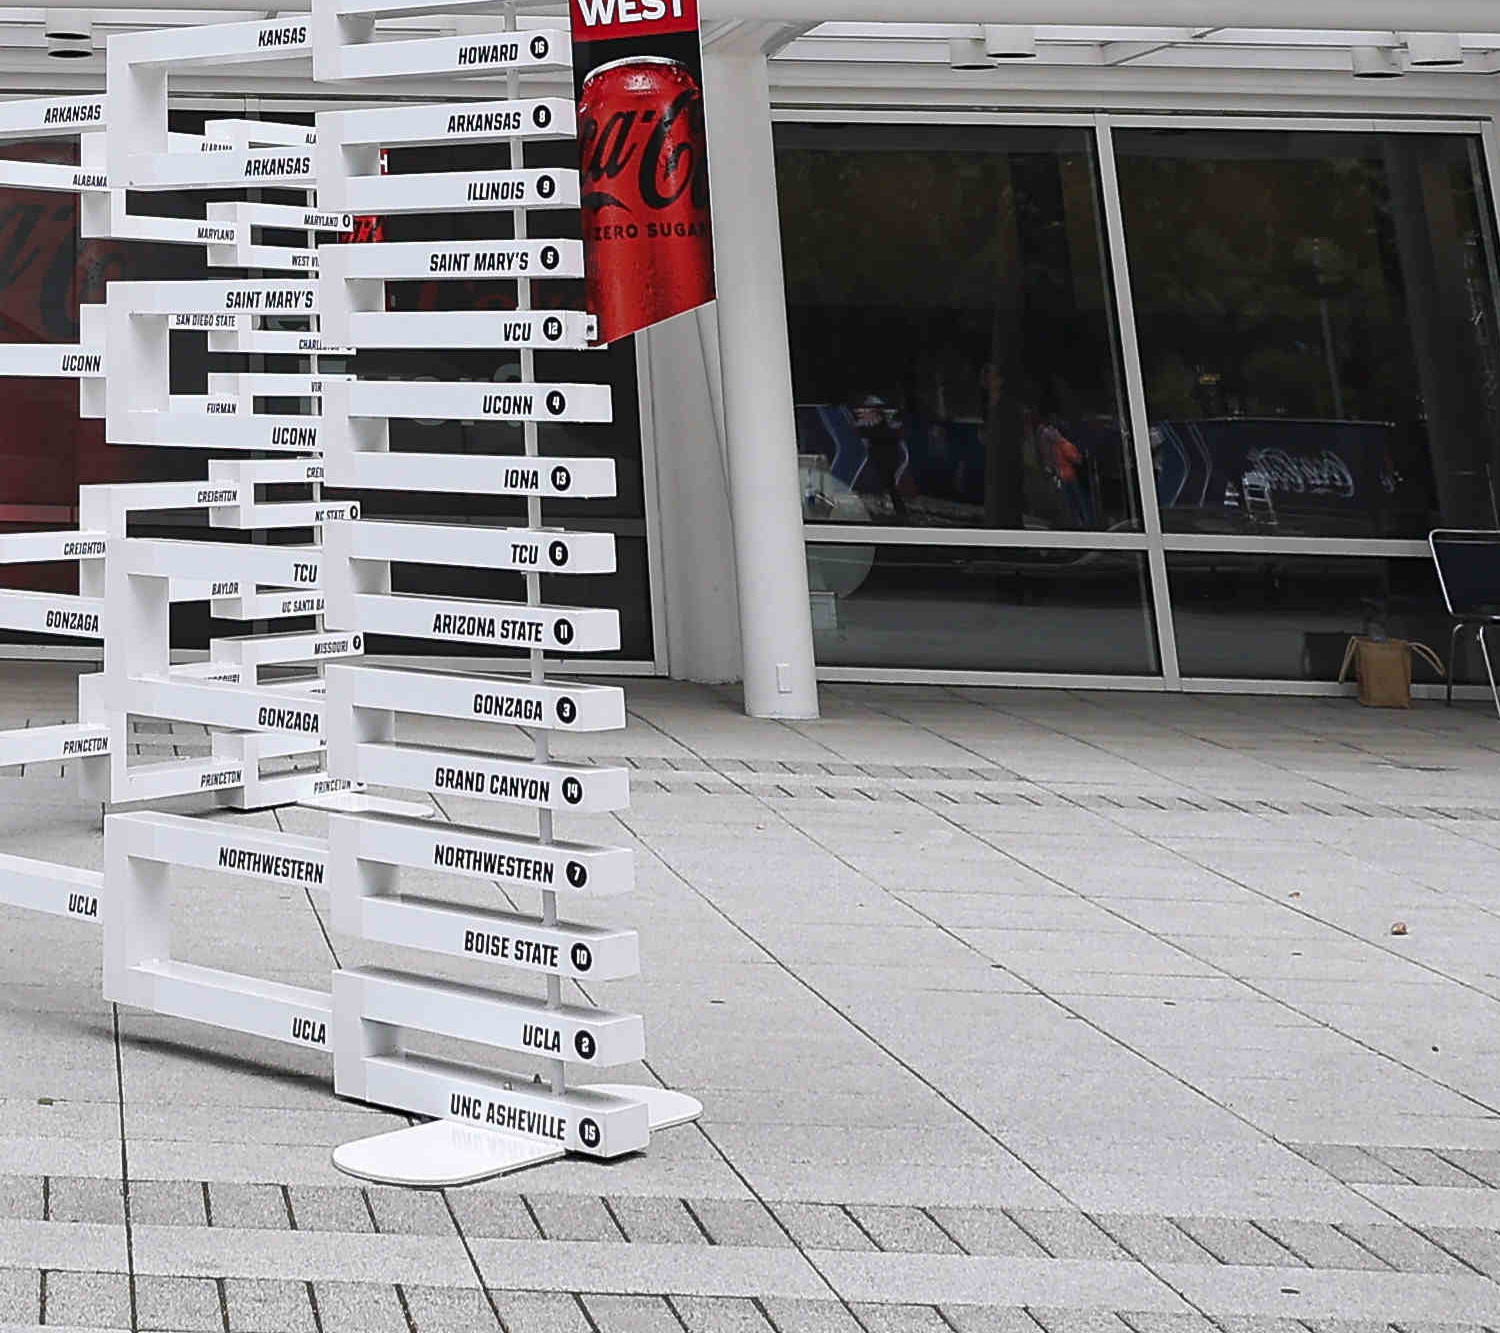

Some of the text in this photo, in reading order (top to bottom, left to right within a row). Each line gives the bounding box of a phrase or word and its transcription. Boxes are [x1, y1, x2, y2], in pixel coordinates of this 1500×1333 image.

[259, 27, 306, 46] KANSAS
[459, 44, 518, 64] HOWARD
[44, 105, 101, 123] ARKANSAS
[448, 112, 521, 133] ARKANSAS
[245, 157, 310, 176] ARKANSAS
[468, 182, 524, 200] ILLINOIS
[304, 215, 338, 227] MARYLAND
[198, 228, 234, 240] MARYLAND
[593, 225, 638, 243] ZERO
[430, 252, 528, 271] SAINT MARY'S
[226, 291, 313, 308] SAINT MARY'S
[504, 323, 531, 341] VCU
[62, 356, 101, 371] UCONN
[483, 395, 532, 414] UCONN
[272, 427, 316, 446] UCONN
[504, 469, 538, 489] IONA
[511, 544, 538, 564] TCU
[294, 564, 317, 582] TCU
[46, 611, 98, 632] GONZAGA
[433, 614, 495, 637] ARIZONA
[501, 620, 543, 642] STATE
[474, 694, 542, 721] GONZAGA
[259, 707, 318, 733] GONZAGA
[64, 738, 108, 753] PRINCETON
[201, 771, 241, 787] PRINCETON
[436, 768, 485, 792] GRAND
[490, 775, 549, 802] CANYON
[219, 848, 323, 883] NORTHWESTERN
[435, 845, 553, 883] NORTHWESTERN
[69, 894, 97, 917] UCLA
[465, 931, 509, 958] BOISE
[515, 940, 558, 967] STATE
[293, 1018, 325, 1047] UCLA
[523, 1025, 560, 1052] UCLA
[451, 1094, 481, 1119] UNC
[486, 1103, 566, 1140] ASHEVILLE
